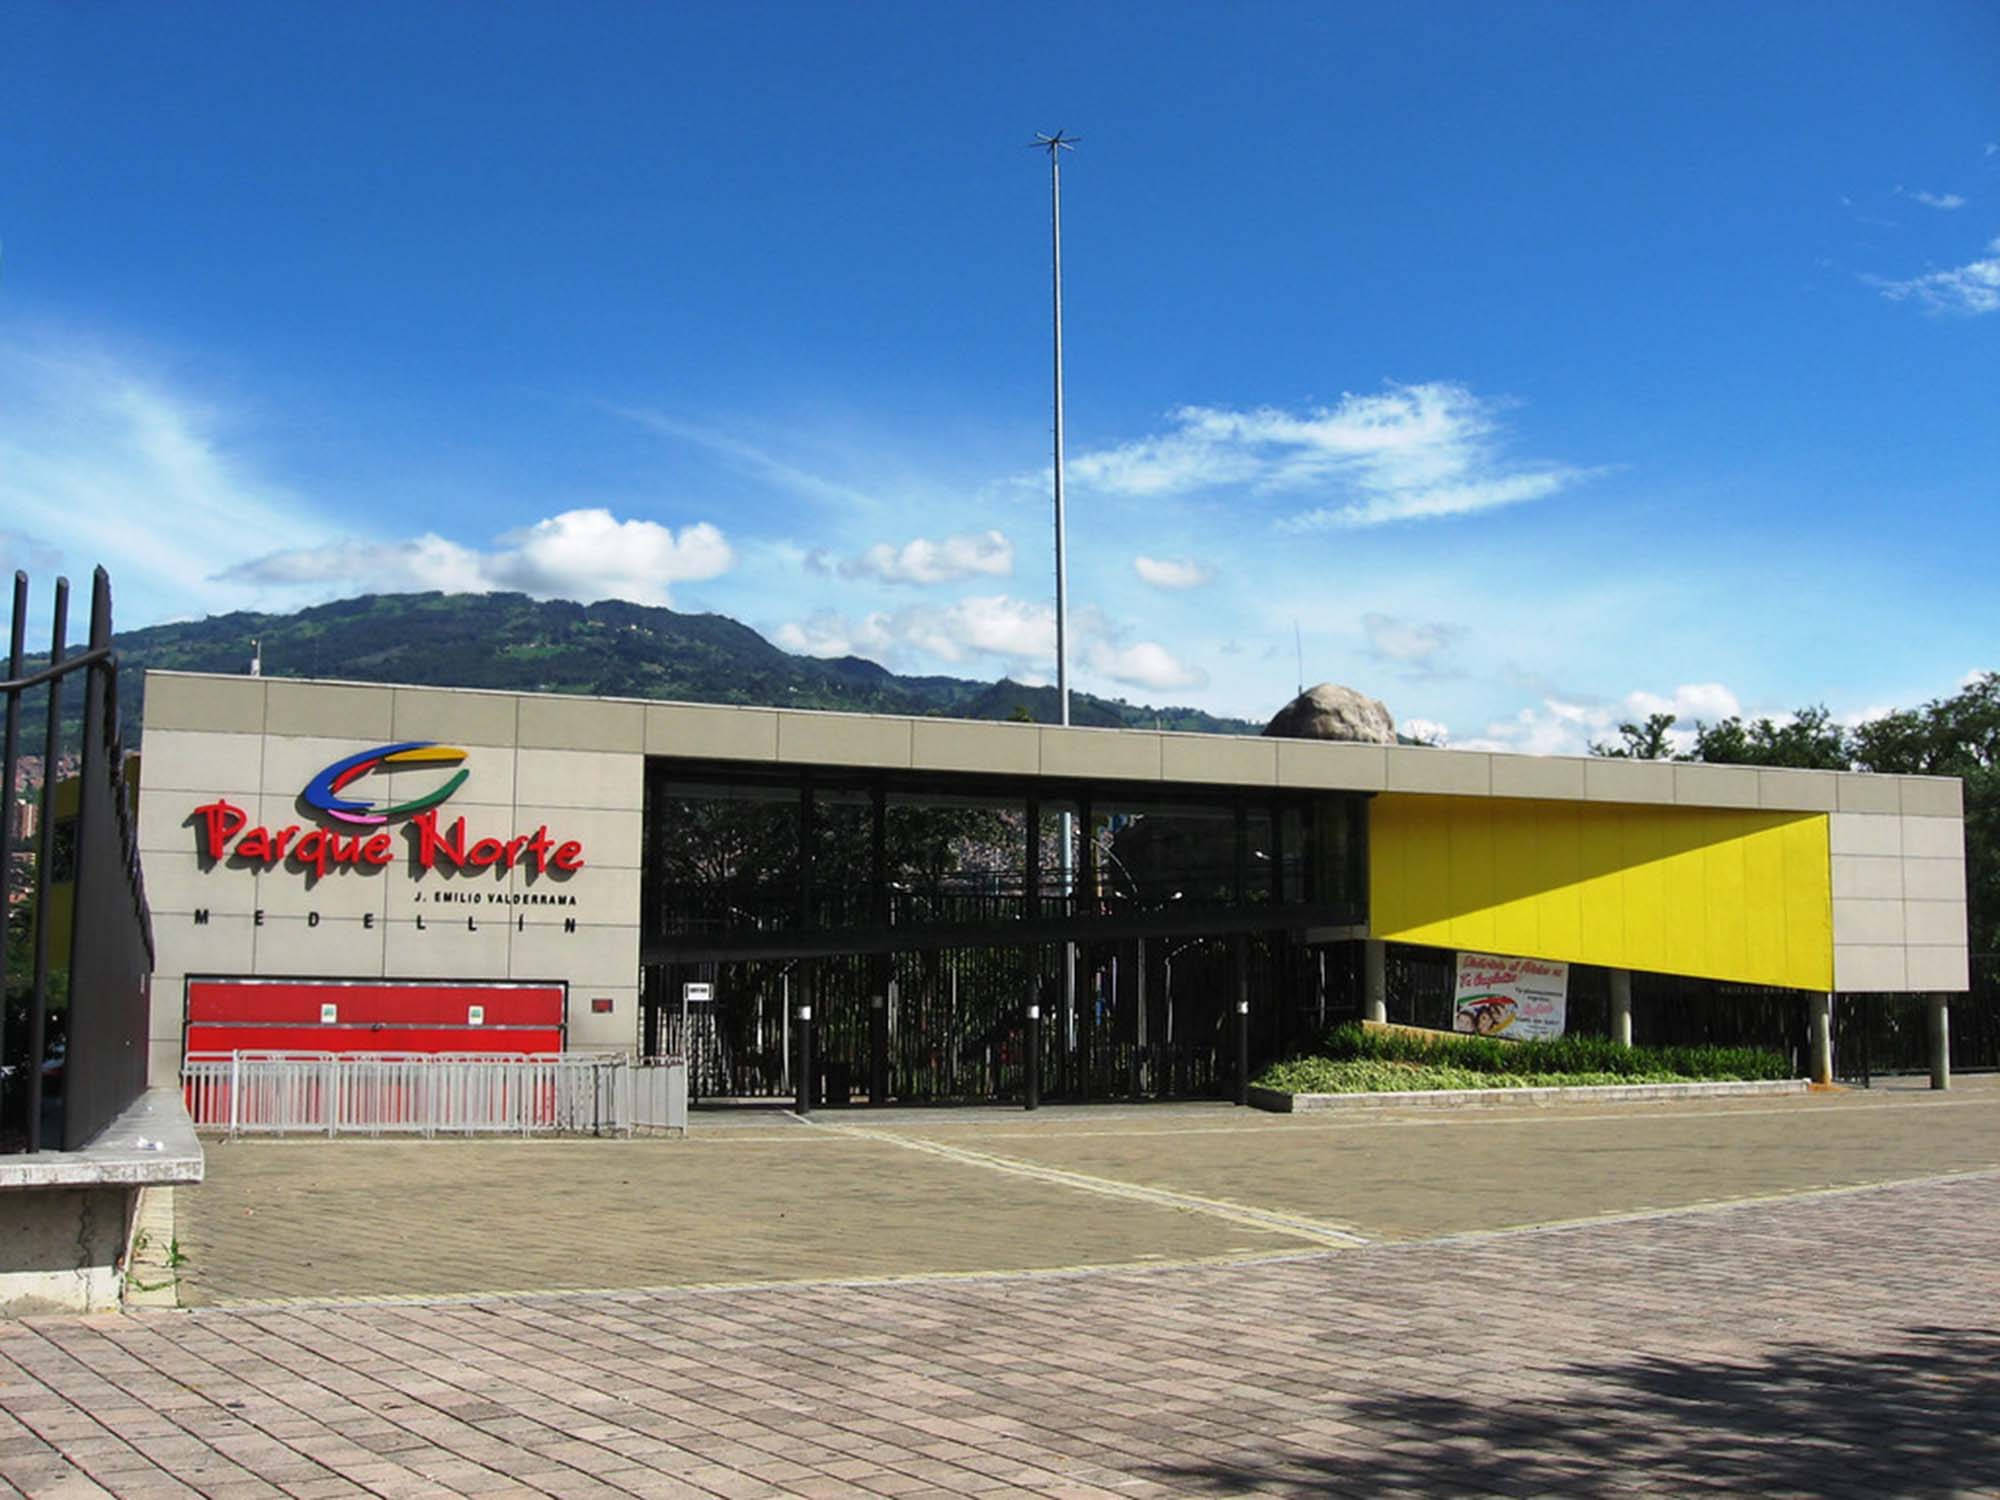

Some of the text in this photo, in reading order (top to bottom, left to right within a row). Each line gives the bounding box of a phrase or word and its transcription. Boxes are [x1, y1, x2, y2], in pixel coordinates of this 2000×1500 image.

[194, 798, 584, 879] Parque Norte
[414, 891, 577, 906] J. EMILIO VALDERRAMA
